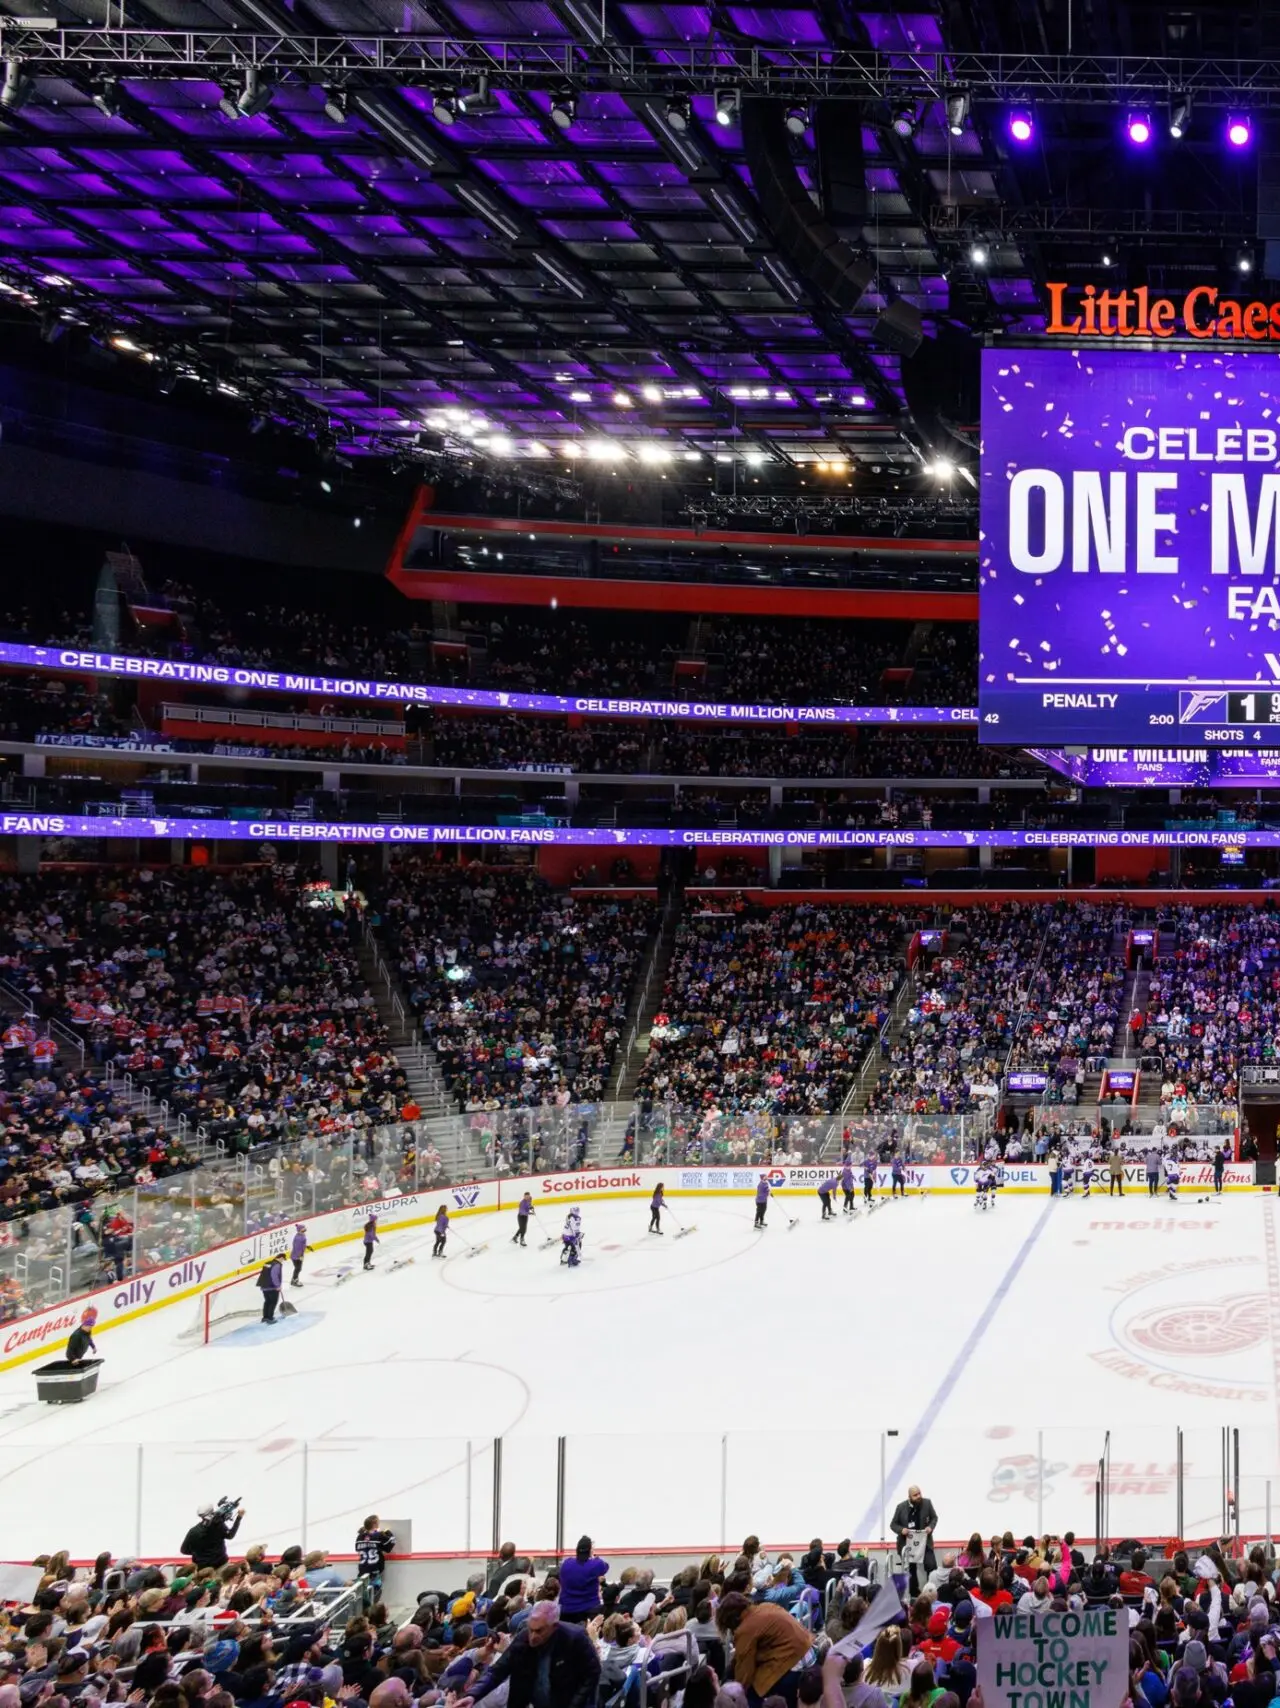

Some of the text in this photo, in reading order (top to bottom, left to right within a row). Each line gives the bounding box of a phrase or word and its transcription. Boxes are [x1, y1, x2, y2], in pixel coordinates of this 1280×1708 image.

[1045, 282, 1176, 336] Little
[1008, 469, 1180, 575] ONE
[60, 651, 428, 701] CELEBRATING ONE MILLION FANS
[575, 698, 837, 720] CELEBRATING ONE MILLION FANS
[1042, 693, 1119, 709] PENALTY
[1240, 693, 1256, 721] 1
[984, 713, 1000, 725] 42
[1149, 714, 1175, 725] 2:00
[1204, 729, 1262, 741] SHOTS 4
[1092, 749, 1208, 763] ONE MILLION
[1136, 763, 1164, 772] FANS
[2, 817, 64, 833] FANS
[249, 823, 554, 842] CELEBRATING ONE MILLION FANS
[683, 831, 914, 844] CELEBRATING ONE MILLION FANS
[1024, 832, 1247, 845] CELEBRATING ONE MILLION FANS
[542, 1172, 641, 1193] Scotiabank
[789, 1170, 842, 1179] PRIORITY
[1003, 1170, 1038, 1182] DUEL
[1198, 1166, 1251, 1184] Hotons
[352, 1196, 419, 1218] AIRSUPRA
[269, 1228, 289, 1240] EYES
[1088, 1217, 1221, 1234] meijer
[269, 1237, 286, 1248] LIPS
[269, 1244, 289, 1256] FACE
[168, 1261, 207, 1289] ally
[113, 1280, 155, 1309] ally
[3, 1314, 77, 1353] Campari
[1087, 1347, 1151, 1382] Little
[1147, 1370, 1269, 1403] Caesars
[1070, 1462, 1193, 1478] BELLE
[1081, 1481, 1173, 1495] TIRE
[994, 1611, 1117, 1640] WELCOME
[1033, 1638, 1069, 1664] TO
[996, 1660, 1108, 1688] HOCKEY
[1006, 1689, 1090, 1708] TOWN
